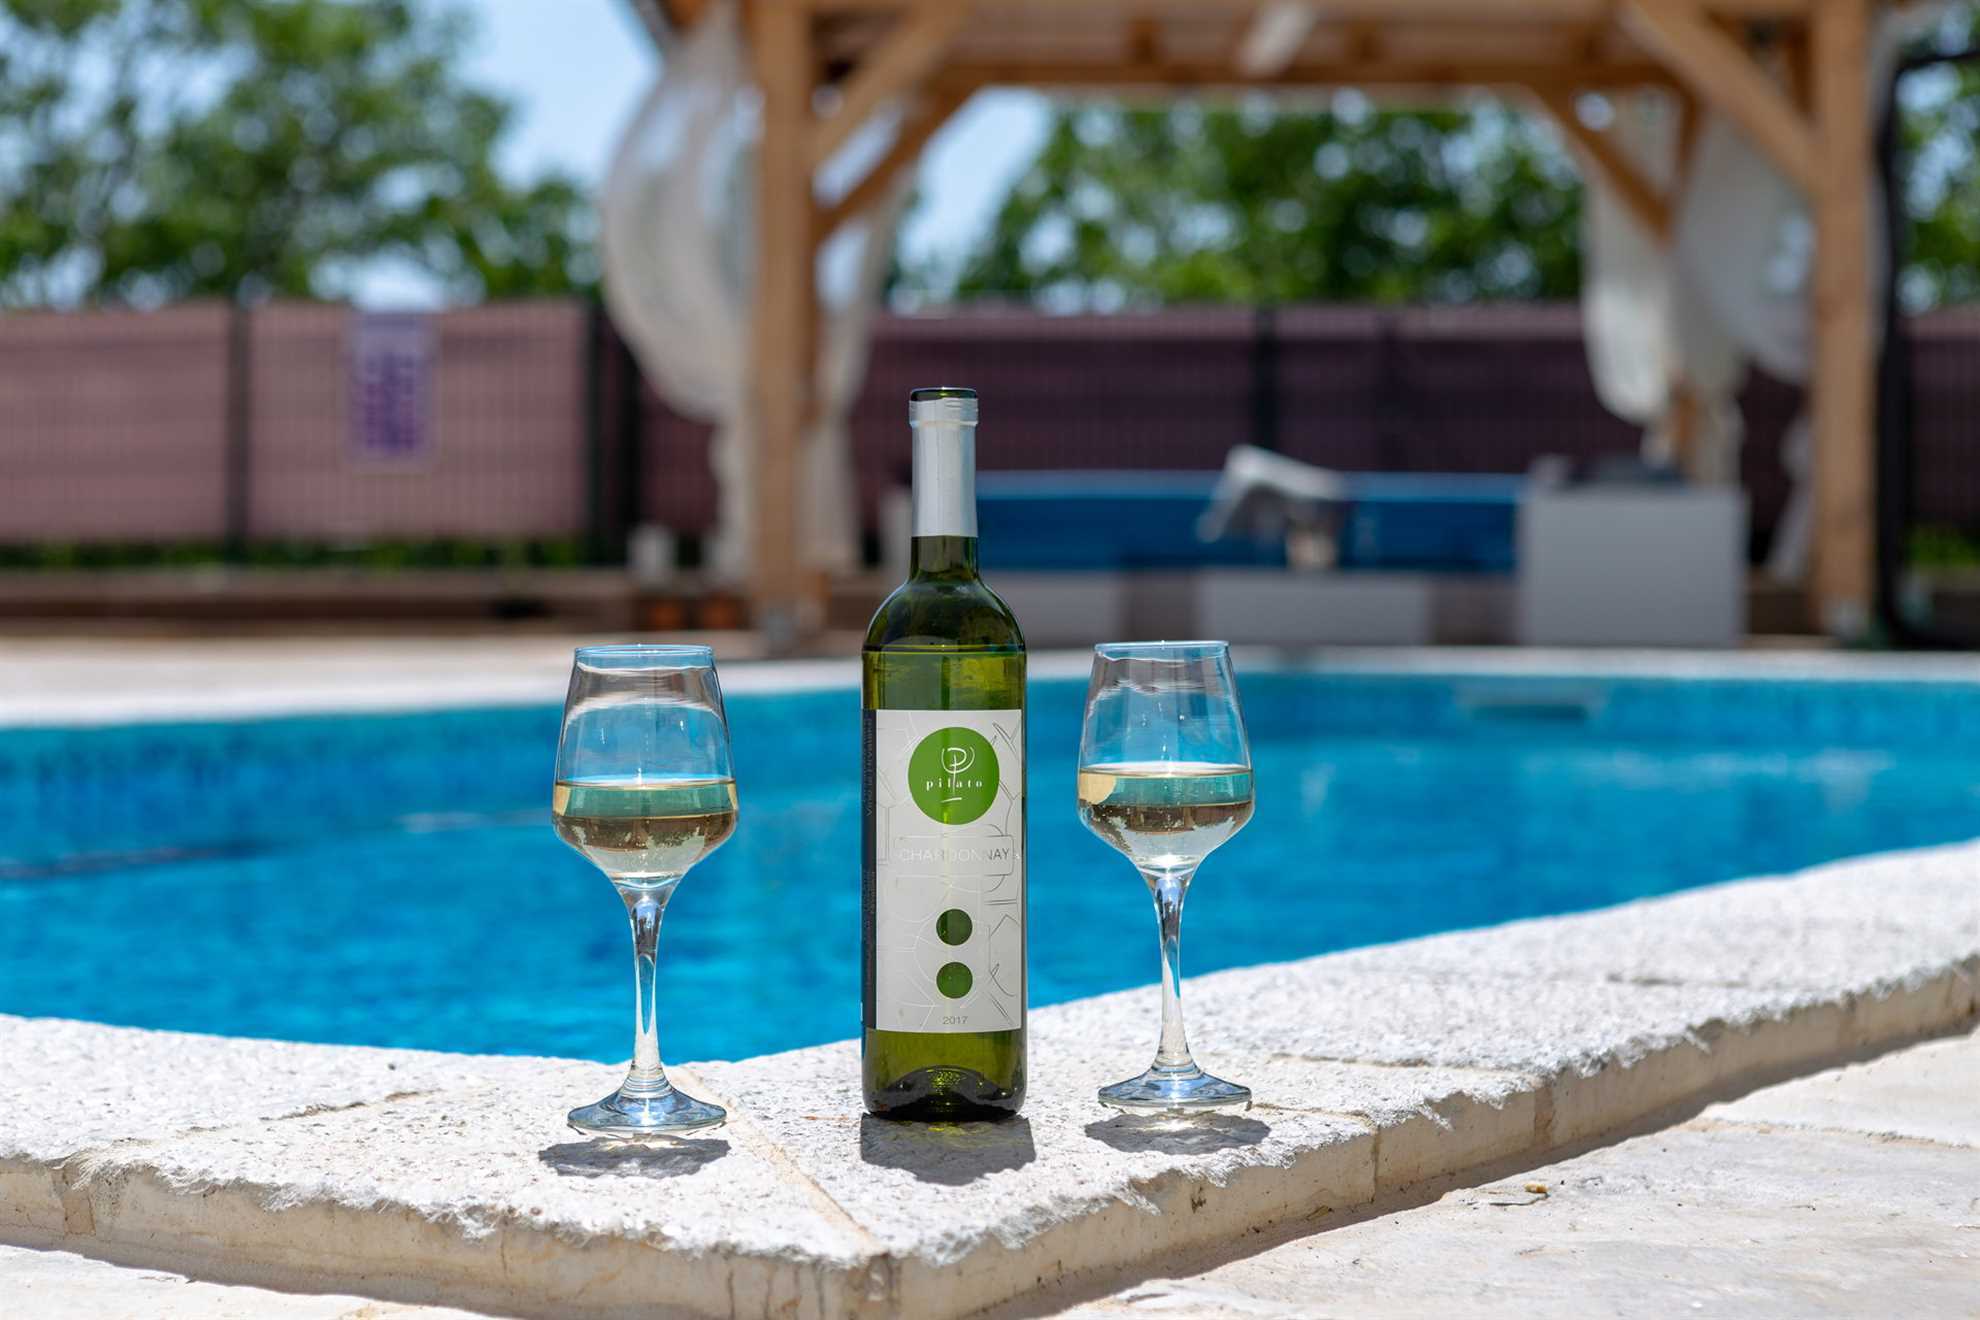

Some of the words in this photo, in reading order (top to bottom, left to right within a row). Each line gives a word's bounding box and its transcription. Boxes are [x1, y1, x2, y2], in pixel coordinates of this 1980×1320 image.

[926, 777, 983, 791] pilato
[902, 847, 1010, 860] CHARDONNAY
[943, 1016, 969, 1025] 2017
